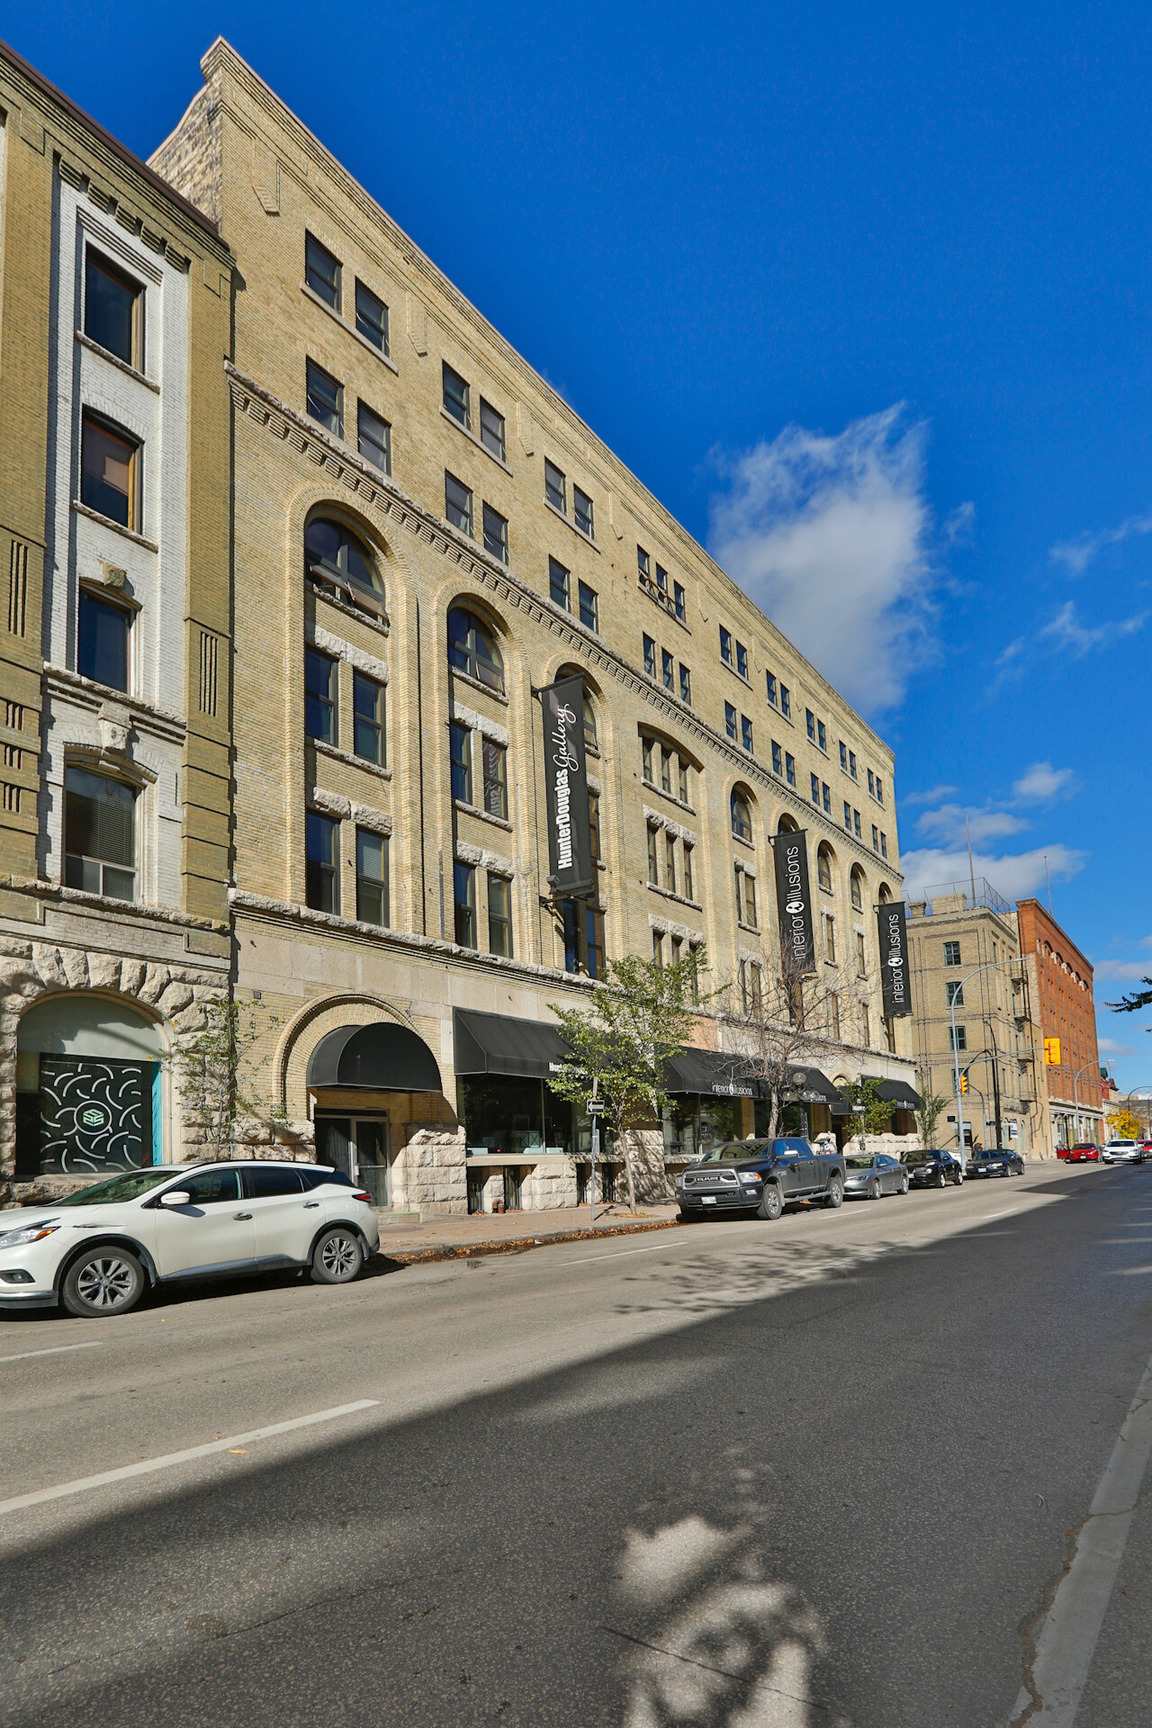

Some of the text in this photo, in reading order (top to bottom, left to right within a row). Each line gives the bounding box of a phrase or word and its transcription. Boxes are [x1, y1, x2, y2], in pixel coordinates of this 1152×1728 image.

[552, 703, 579, 870] HunterDouglas Gallery
[785, 846, 806, 961] interior illusions
[887, 914, 905, 1004] interior illusions
